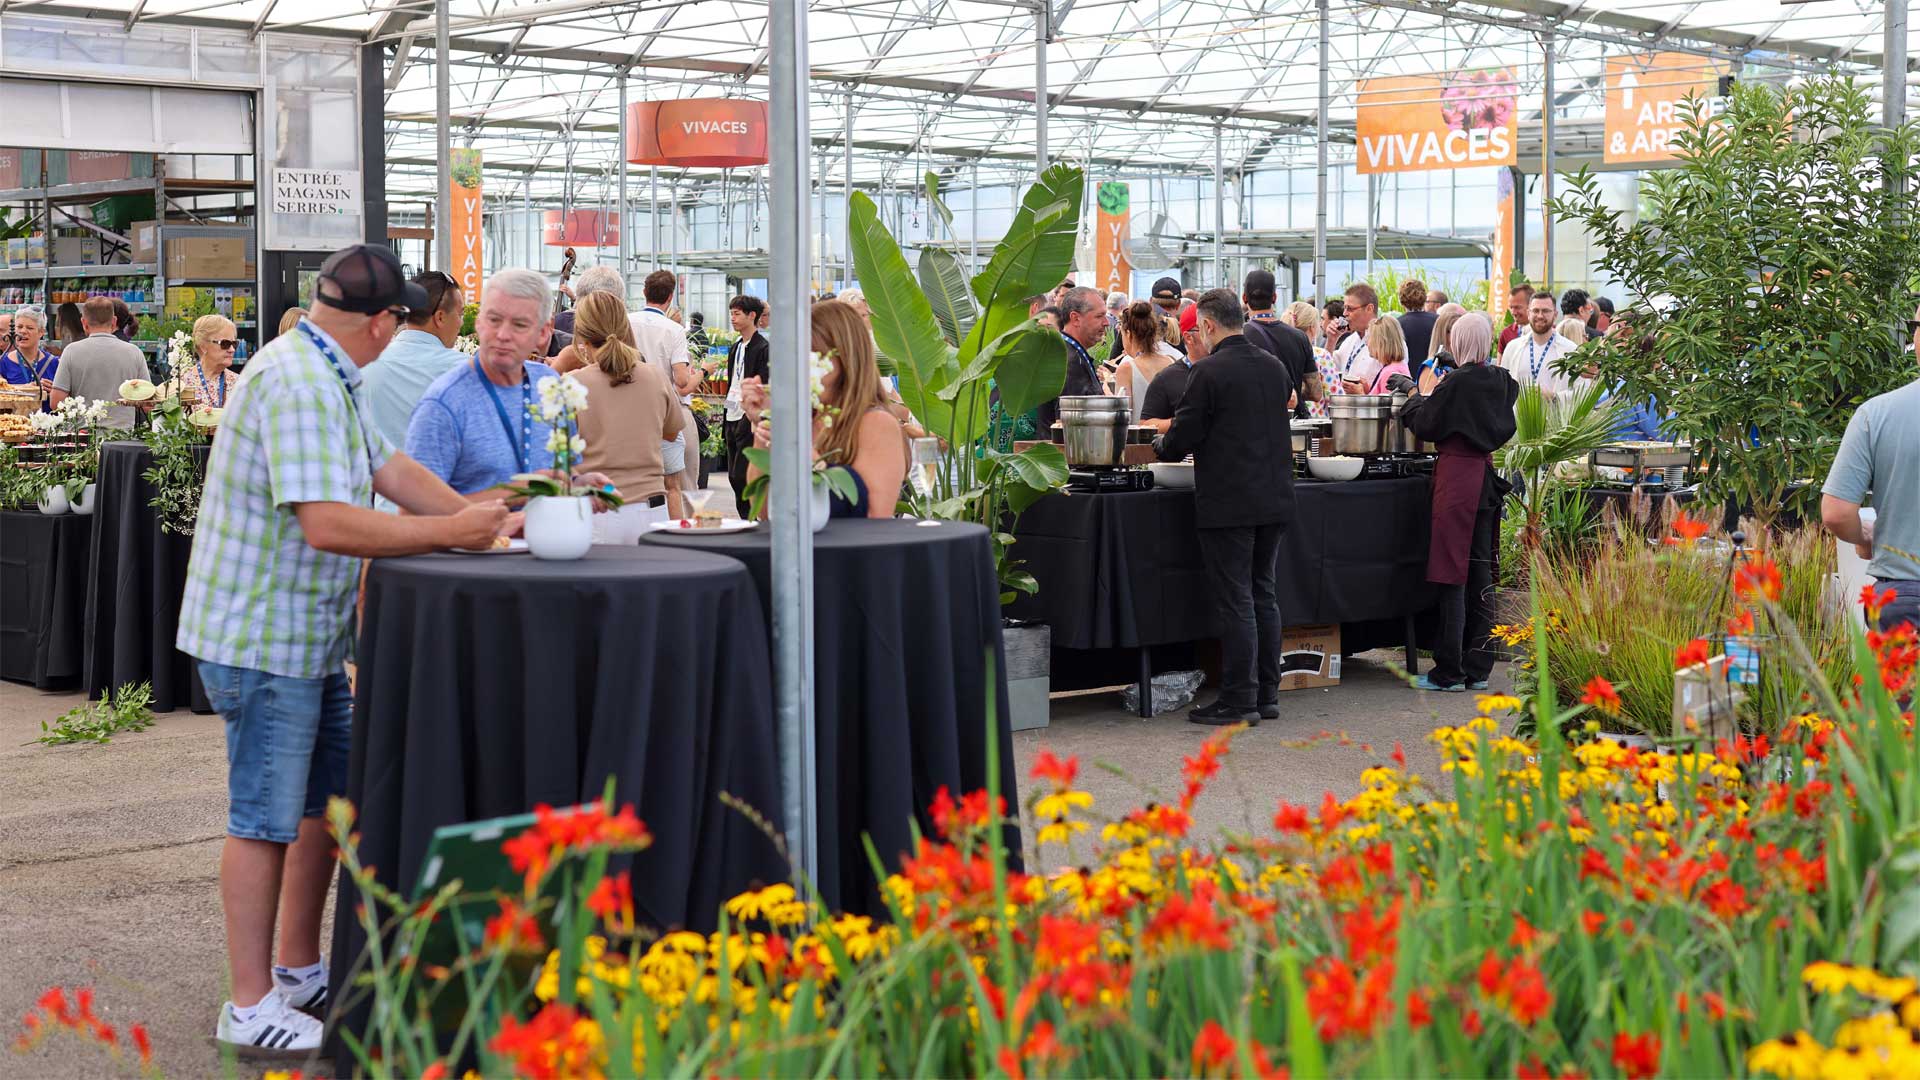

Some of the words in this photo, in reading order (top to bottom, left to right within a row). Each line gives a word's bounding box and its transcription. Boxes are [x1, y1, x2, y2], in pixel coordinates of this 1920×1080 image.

[682, 121, 748, 134] VIVACES
[1362, 126, 1510, 168] VIVACES
[1609, 130, 1627, 155] &
[277, 171, 342, 186] ENTRÉE
[278, 187, 352, 200] MAGASIN
[463, 198, 477, 305] VIVACE
